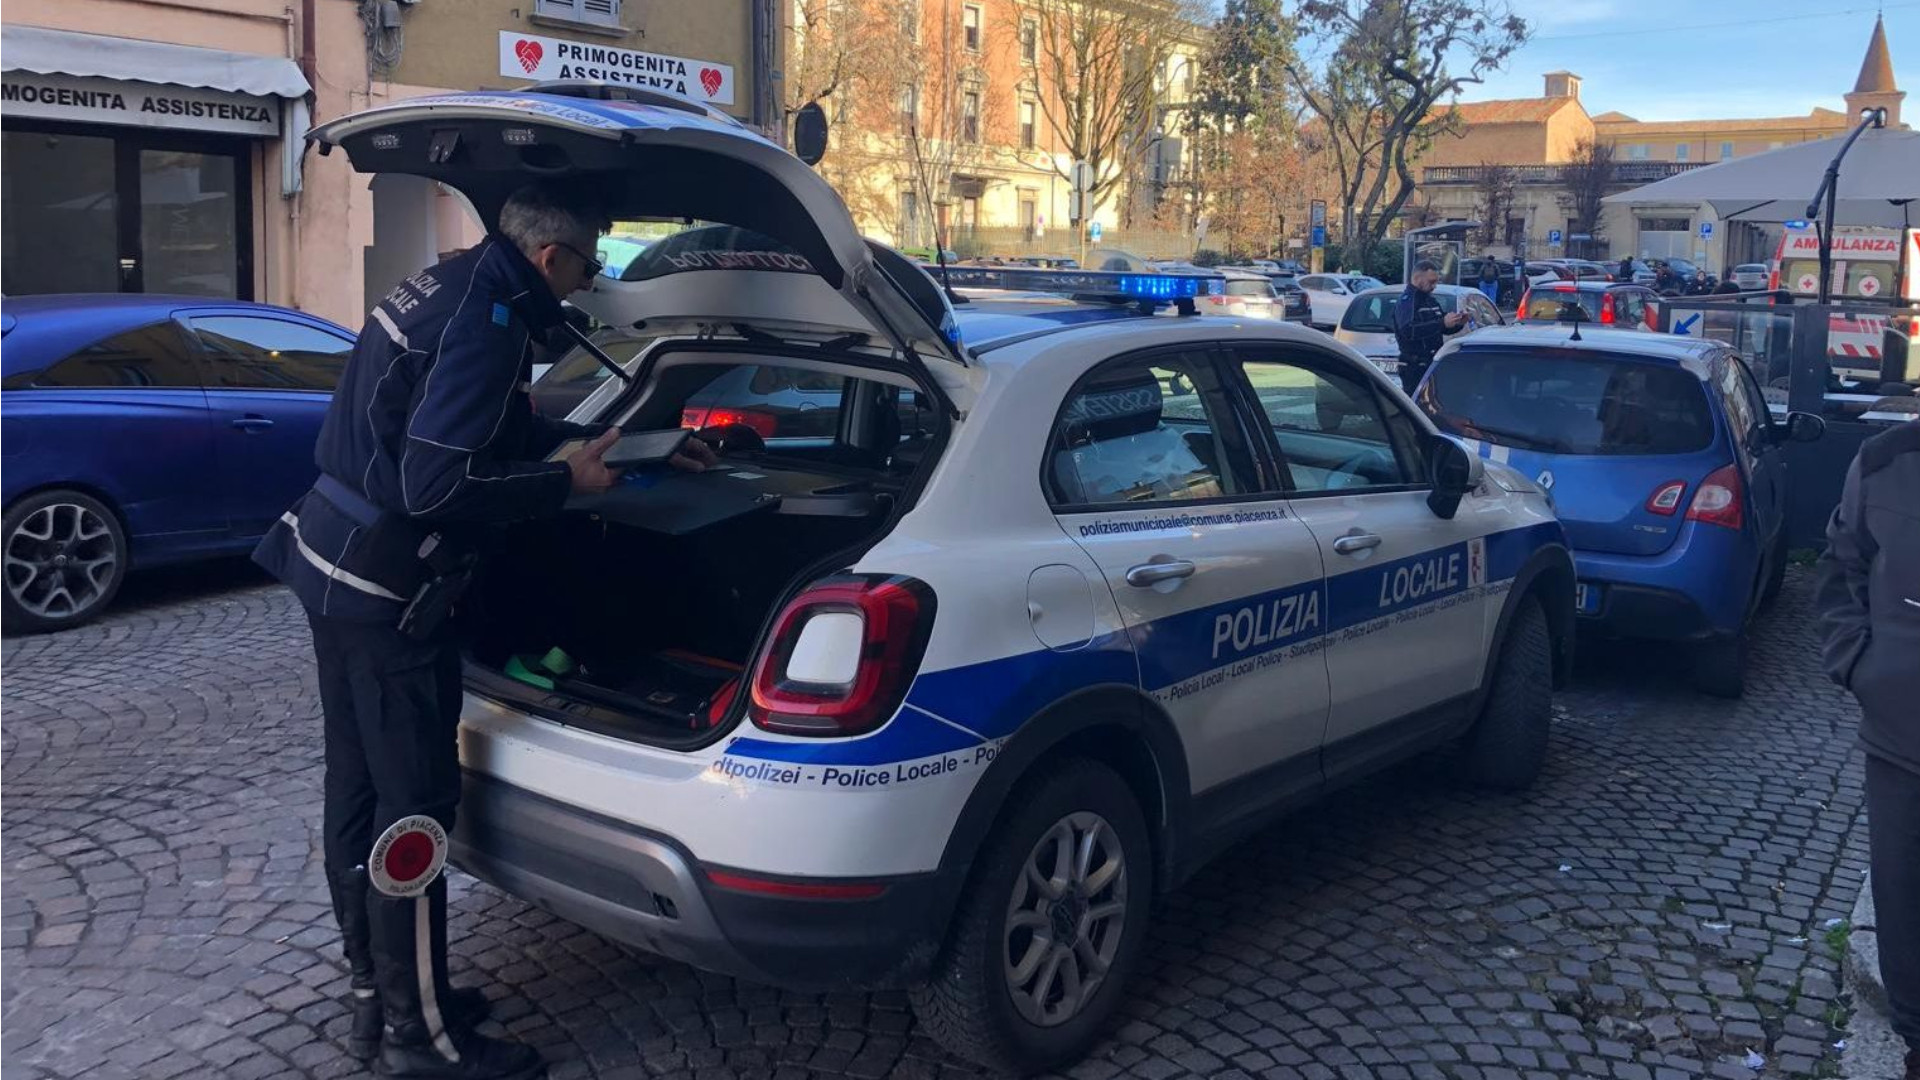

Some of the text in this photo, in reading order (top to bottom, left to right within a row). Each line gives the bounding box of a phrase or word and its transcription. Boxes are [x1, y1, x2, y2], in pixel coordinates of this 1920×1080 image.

[557, 43, 687, 76] PRIMOGENITA
[559, 64, 687, 95] ASSISTENZA
[0, 83, 272, 123] MOGENITA ASSISTENZA
[1793, 237, 1896, 252] AMULANZA
[1080, 508, 1287, 536] poliziamunicipale@comune.piacenza.it
[1212, 553, 1460, 660] POLIZIA LOCALE
[713, 756, 801, 784] dtpolizei
[821, 767, 890, 787] Police
[896, 755, 958, 783] Locale
